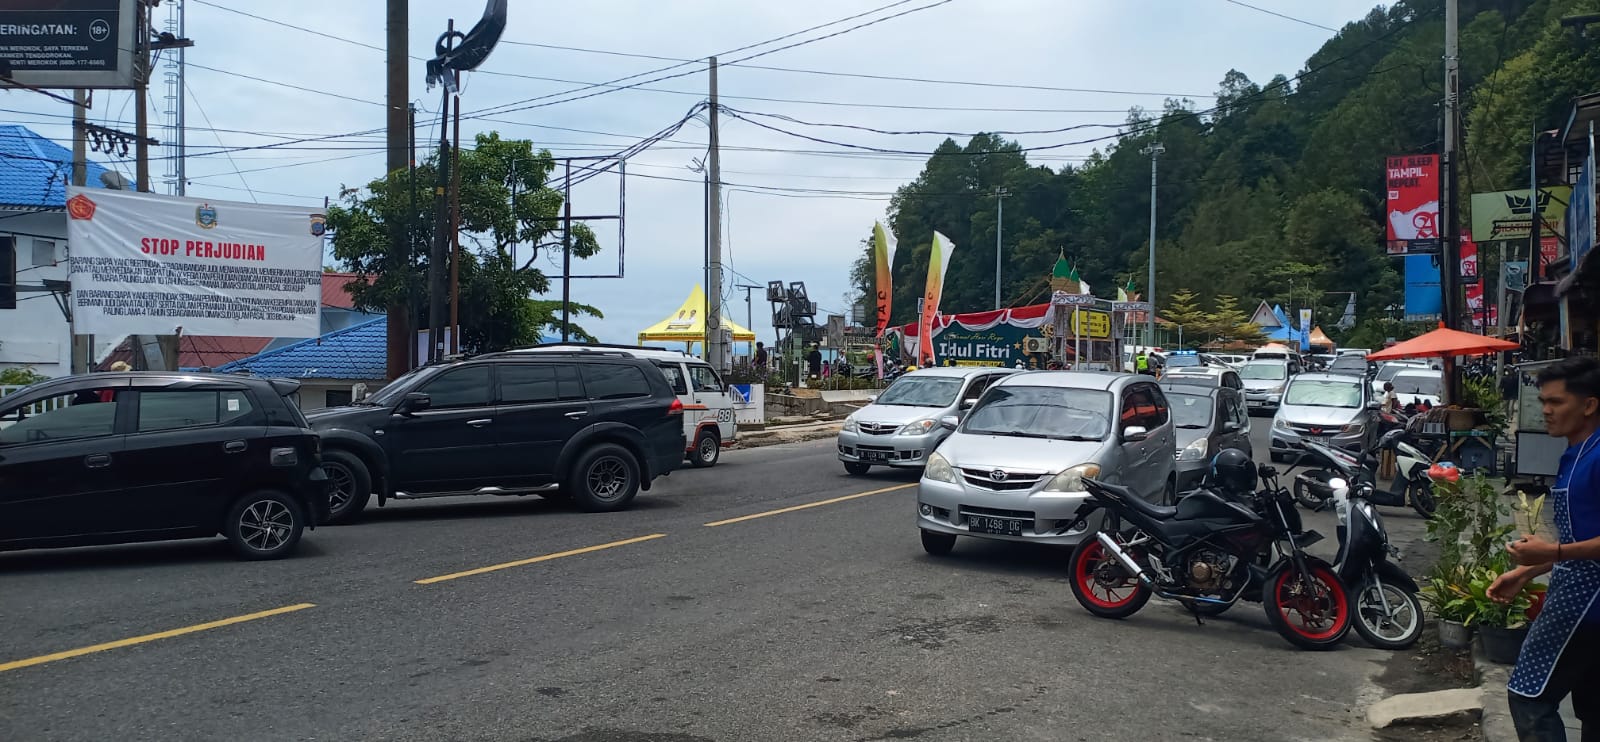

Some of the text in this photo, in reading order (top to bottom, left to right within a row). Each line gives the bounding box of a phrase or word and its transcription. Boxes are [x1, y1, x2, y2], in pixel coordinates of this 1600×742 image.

[92, 26, 108, 34] 18+
[1388, 167, 1428, 178] TAMPIL,
[141, 238, 265, 261] STOP PERJUDIAN
[939, 343, 1010, 358] Idul Fitri
[717, 408, 731, 422] 88
